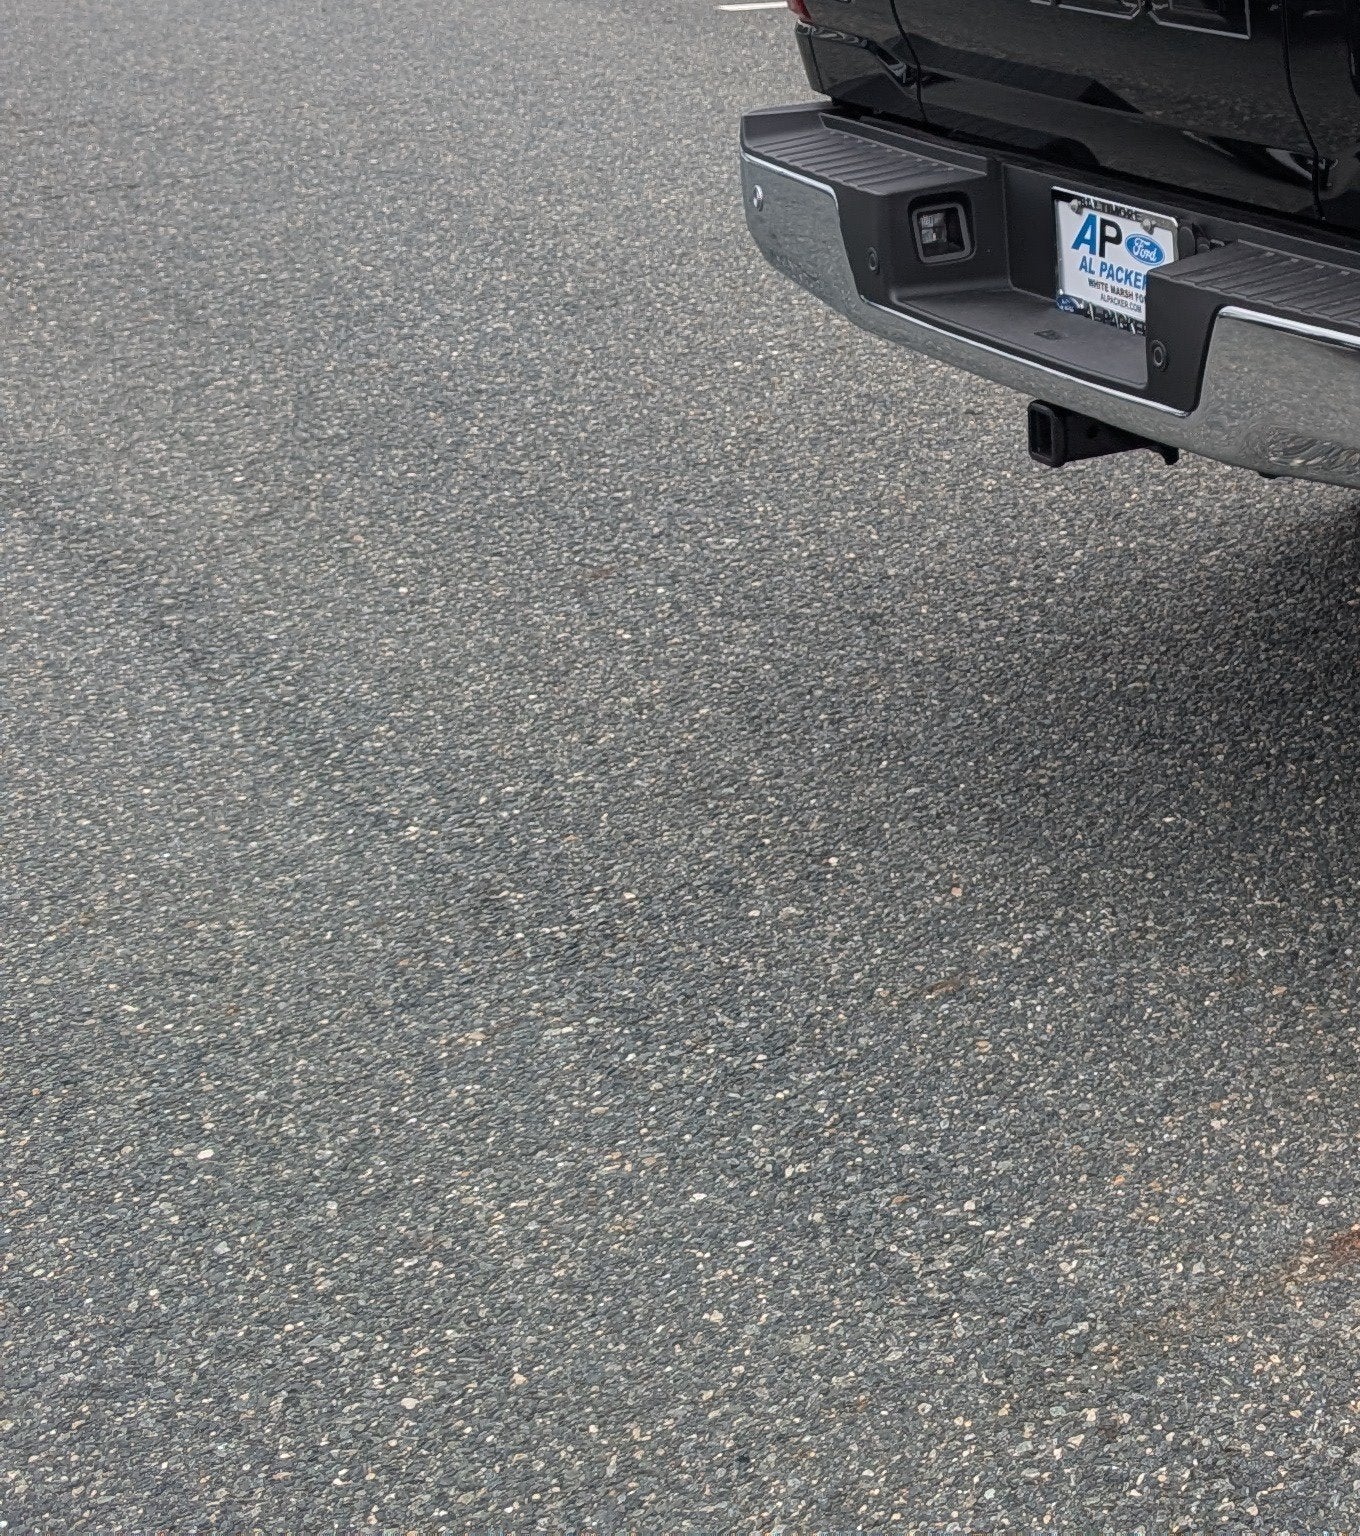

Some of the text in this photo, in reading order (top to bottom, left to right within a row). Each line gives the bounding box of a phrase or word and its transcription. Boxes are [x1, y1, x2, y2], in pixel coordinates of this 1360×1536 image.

[1071, 213, 1123, 258] AP
[1079, 255, 1096, 275] AL
[1088, 277, 1109, 293] WHITE
[1110, 283, 1134, 300] MARSH
